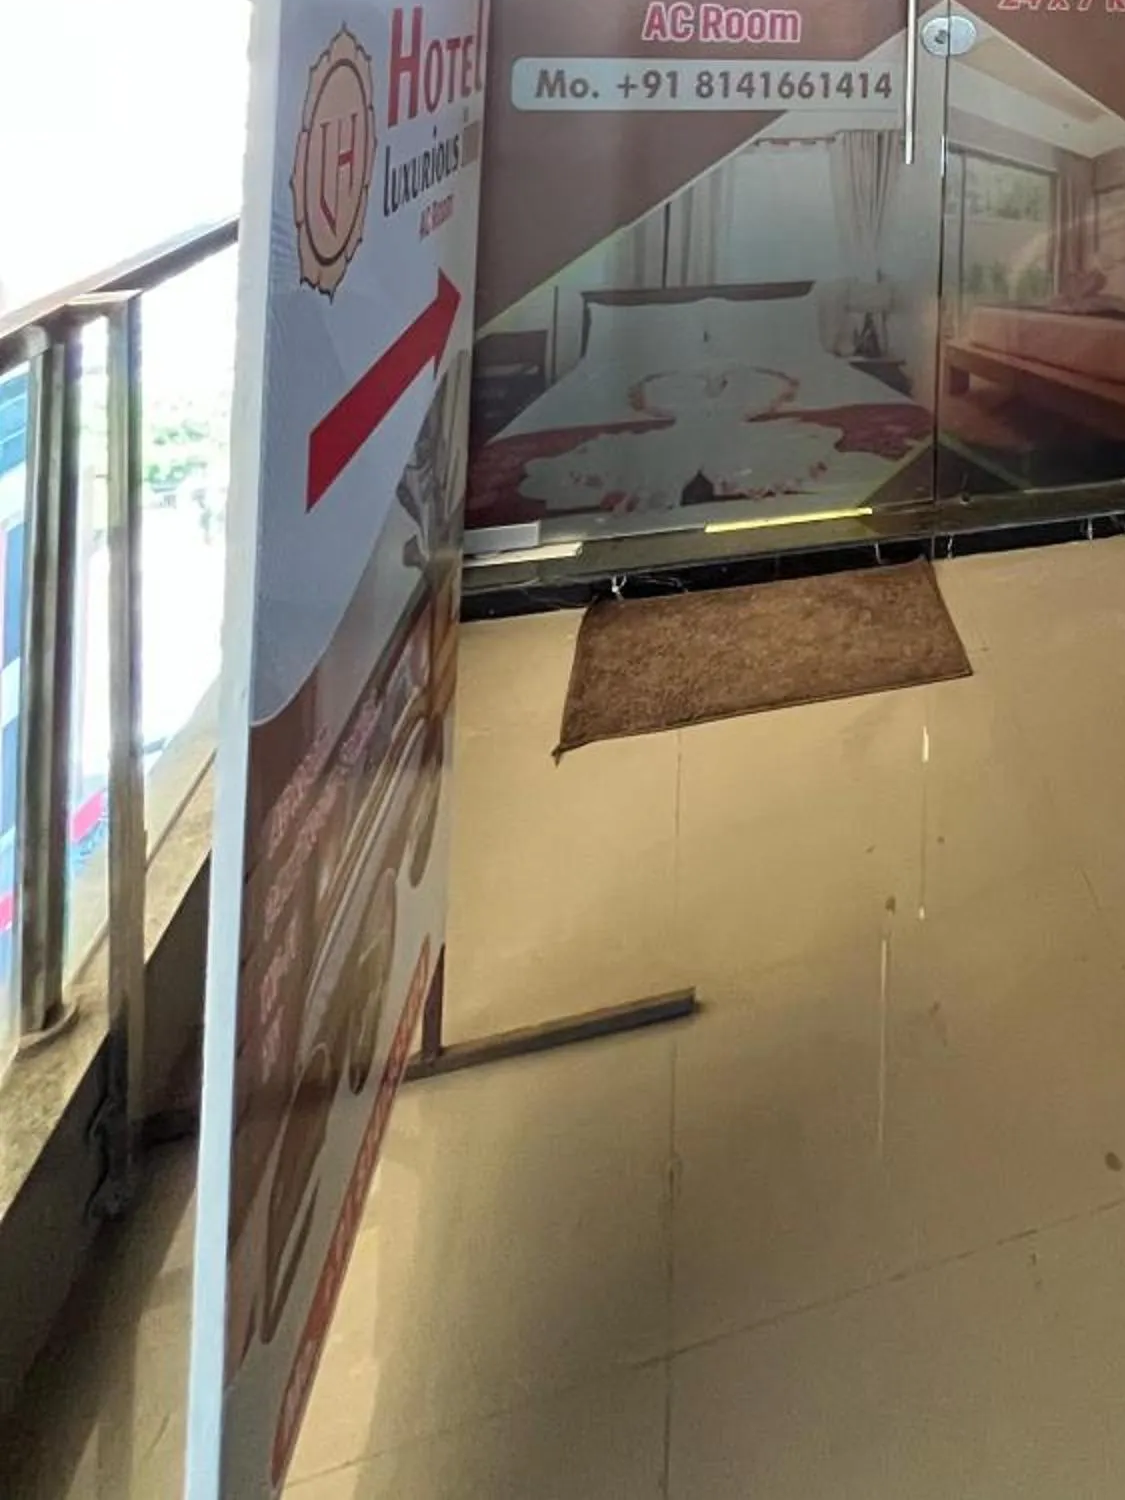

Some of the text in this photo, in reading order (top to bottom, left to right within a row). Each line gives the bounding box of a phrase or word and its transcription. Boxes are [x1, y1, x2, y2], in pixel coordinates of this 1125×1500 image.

[641, 1, 802, 43] AC Room
[535, 69, 893, 100] Mo. +91 8141661414
